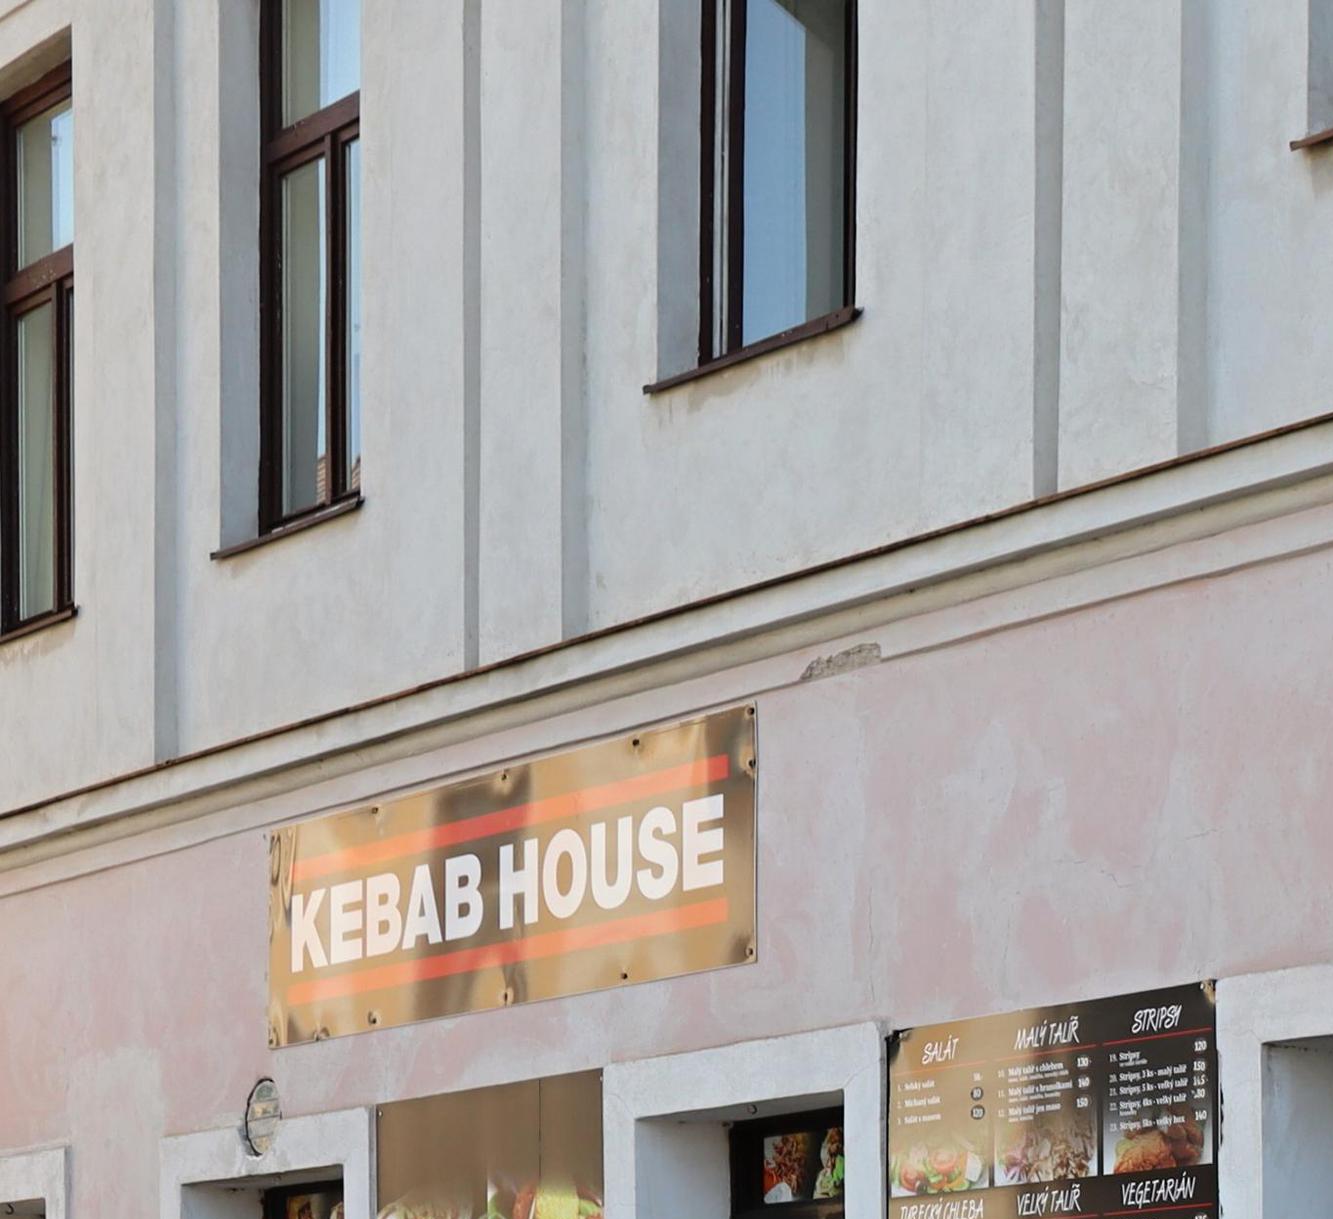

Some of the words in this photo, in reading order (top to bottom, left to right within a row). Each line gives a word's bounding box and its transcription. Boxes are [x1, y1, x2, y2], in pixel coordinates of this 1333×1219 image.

[291, 854, 483, 973] KEBAB
[500, 794, 724, 930] HOUSE
[1131, 1005, 1182, 1033] STRIPSY
[922, 1035, 959, 1064] SALÁT
[1014, 1020, 1047, 1050] MALÝ
[1194, 1040, 1207, 1051] 120
[1193, 1061, 1205, 1071] 150
[1017, 1186, 1049, 1216] VELKÝ
[1122, 1171, 1196, 1209] VEGETARIÁN
